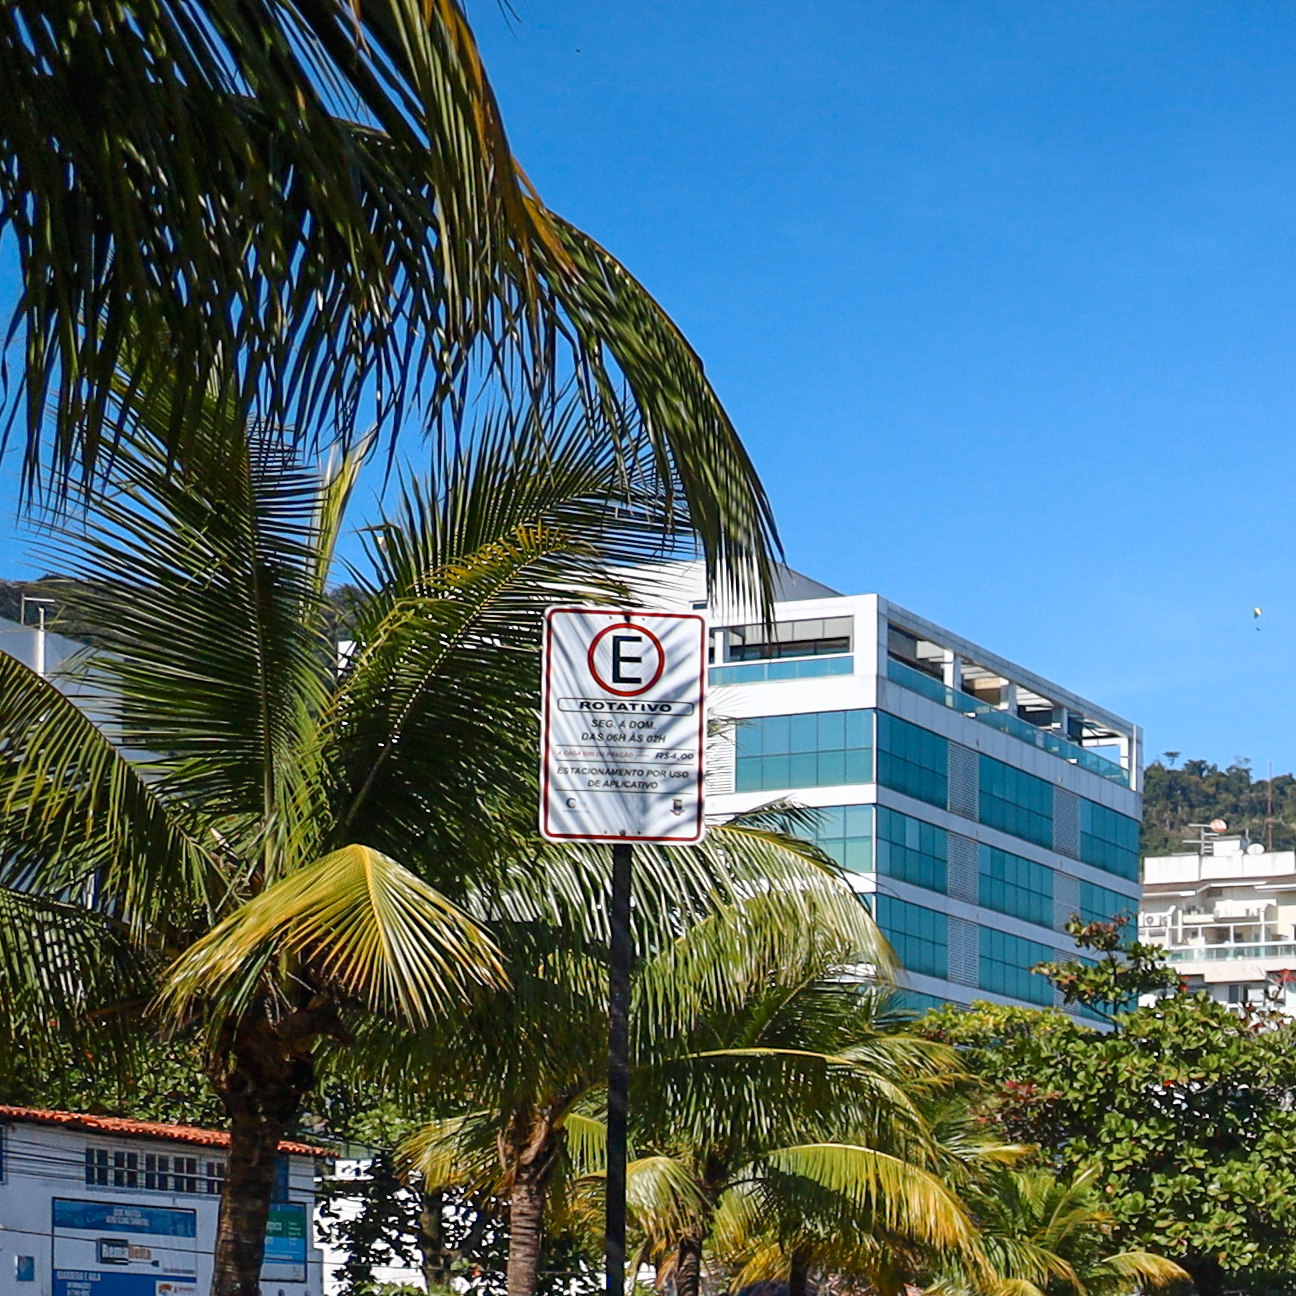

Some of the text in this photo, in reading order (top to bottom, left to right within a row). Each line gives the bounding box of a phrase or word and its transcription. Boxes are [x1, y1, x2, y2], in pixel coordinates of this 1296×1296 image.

[612, 635, 642, 684] E
[579, 701, 672, 713] ROTATIVO
[591, 719, 657, 730] SEG. A DOM.
[581, 732, 603, 742] DAS
[606, 733, 627, 742] 06H
[628, 732, 644, 743] ÀS
[556, 766, 690, 779] ESTACIONAMENTO POR USO
[588, 779, 659, 790] DE APLICATIVO
